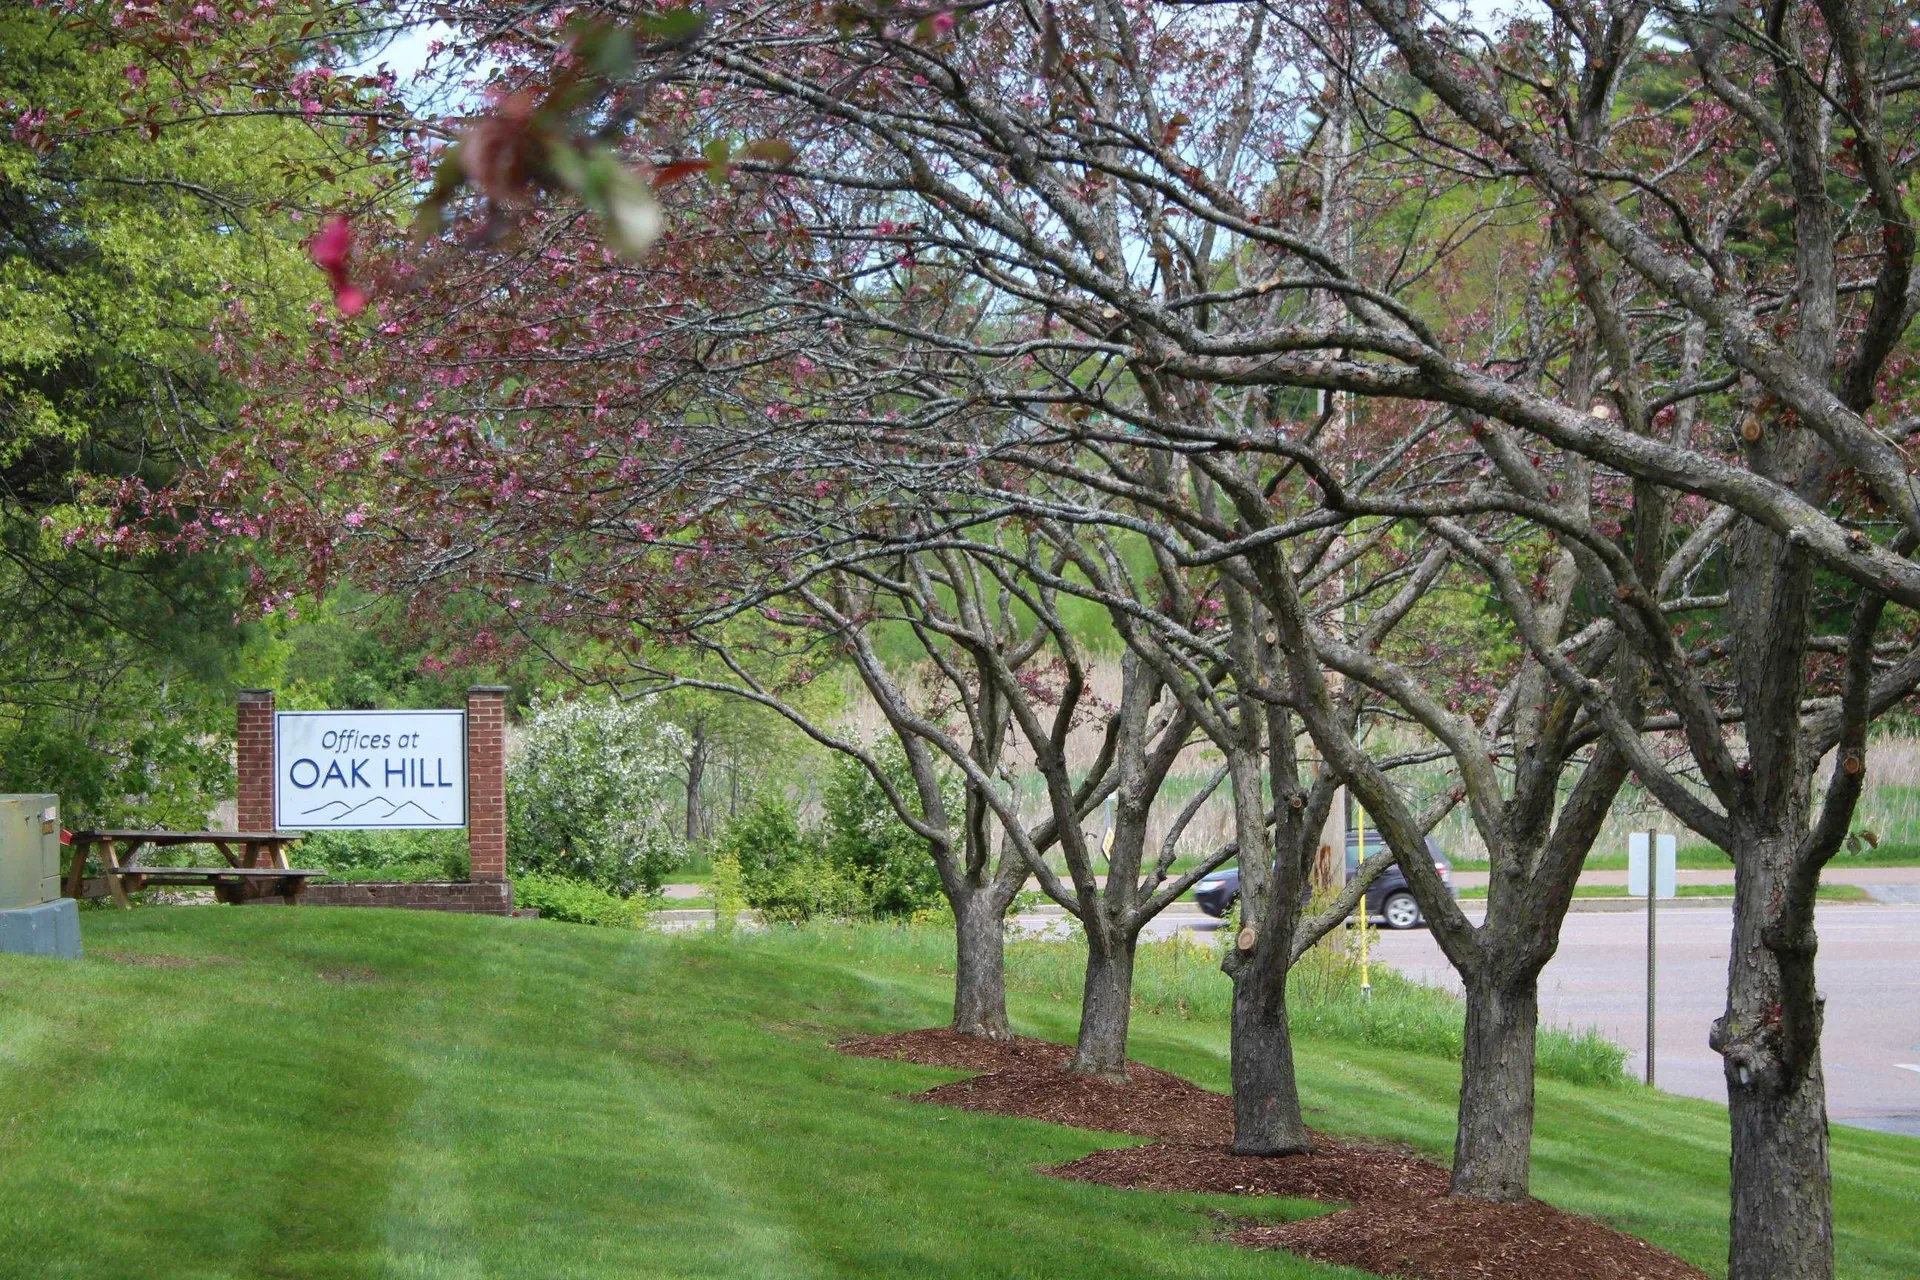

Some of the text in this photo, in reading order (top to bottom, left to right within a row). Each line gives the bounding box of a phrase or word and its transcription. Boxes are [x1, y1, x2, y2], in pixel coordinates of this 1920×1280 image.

[322, 729, 420, 754] Offices at
[289, 758, 453, 789] OAK HILL
